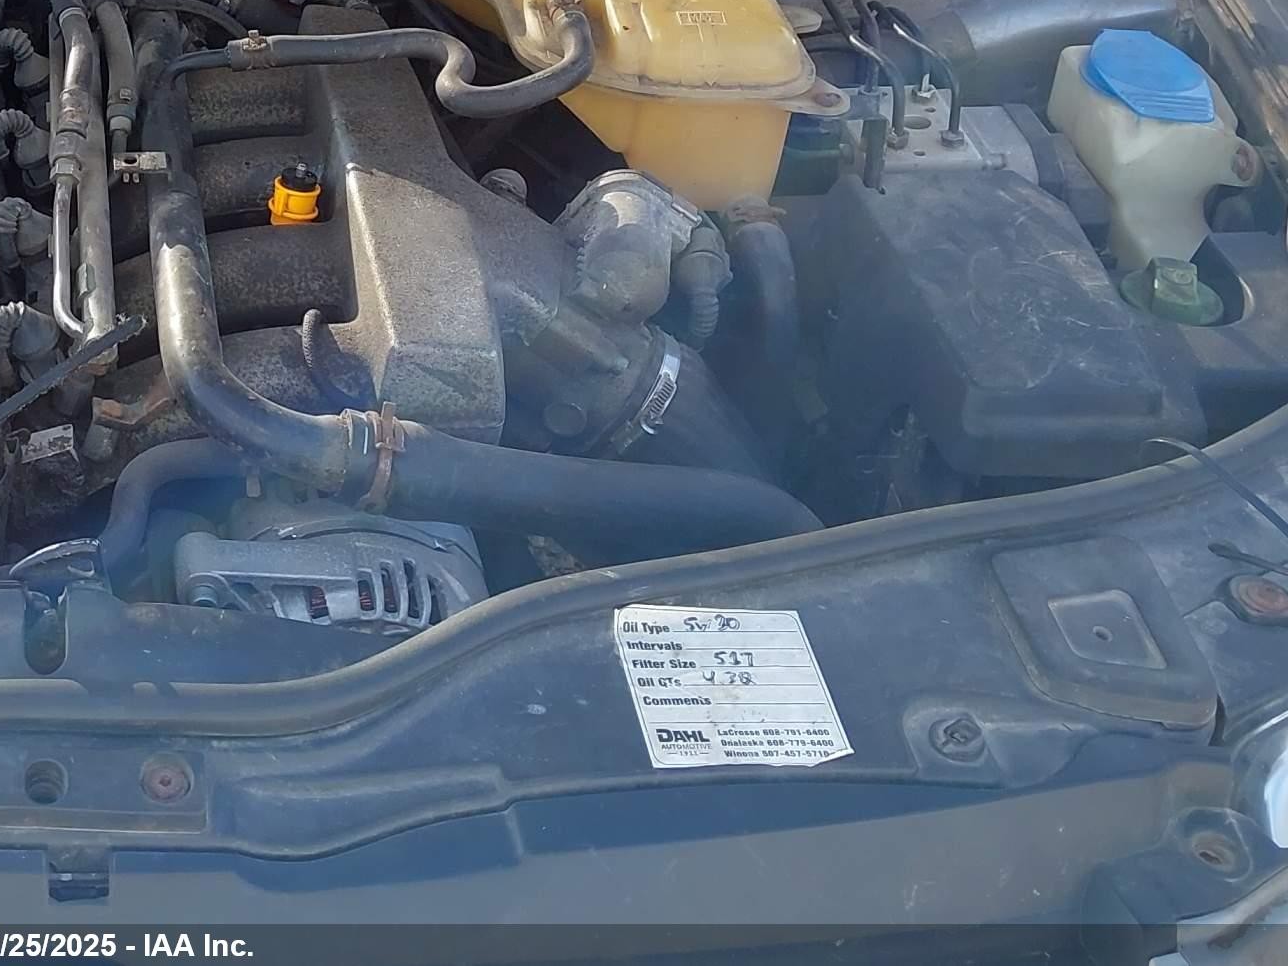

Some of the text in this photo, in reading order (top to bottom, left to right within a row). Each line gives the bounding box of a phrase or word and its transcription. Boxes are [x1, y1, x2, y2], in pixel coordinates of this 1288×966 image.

[622, 621, 670, 634] Oil Type
[626, 640, 683, 651] Intervals
[631, 658, 697, 669] Filter Size
[637, 677, 655, 687] Oil
[642, 695, 712, 706] Comments
[655, 728, 711, 743] DAHL
[717, 729, 760, 737] LaCrosse
[723, 750, 760, 758] Winona
